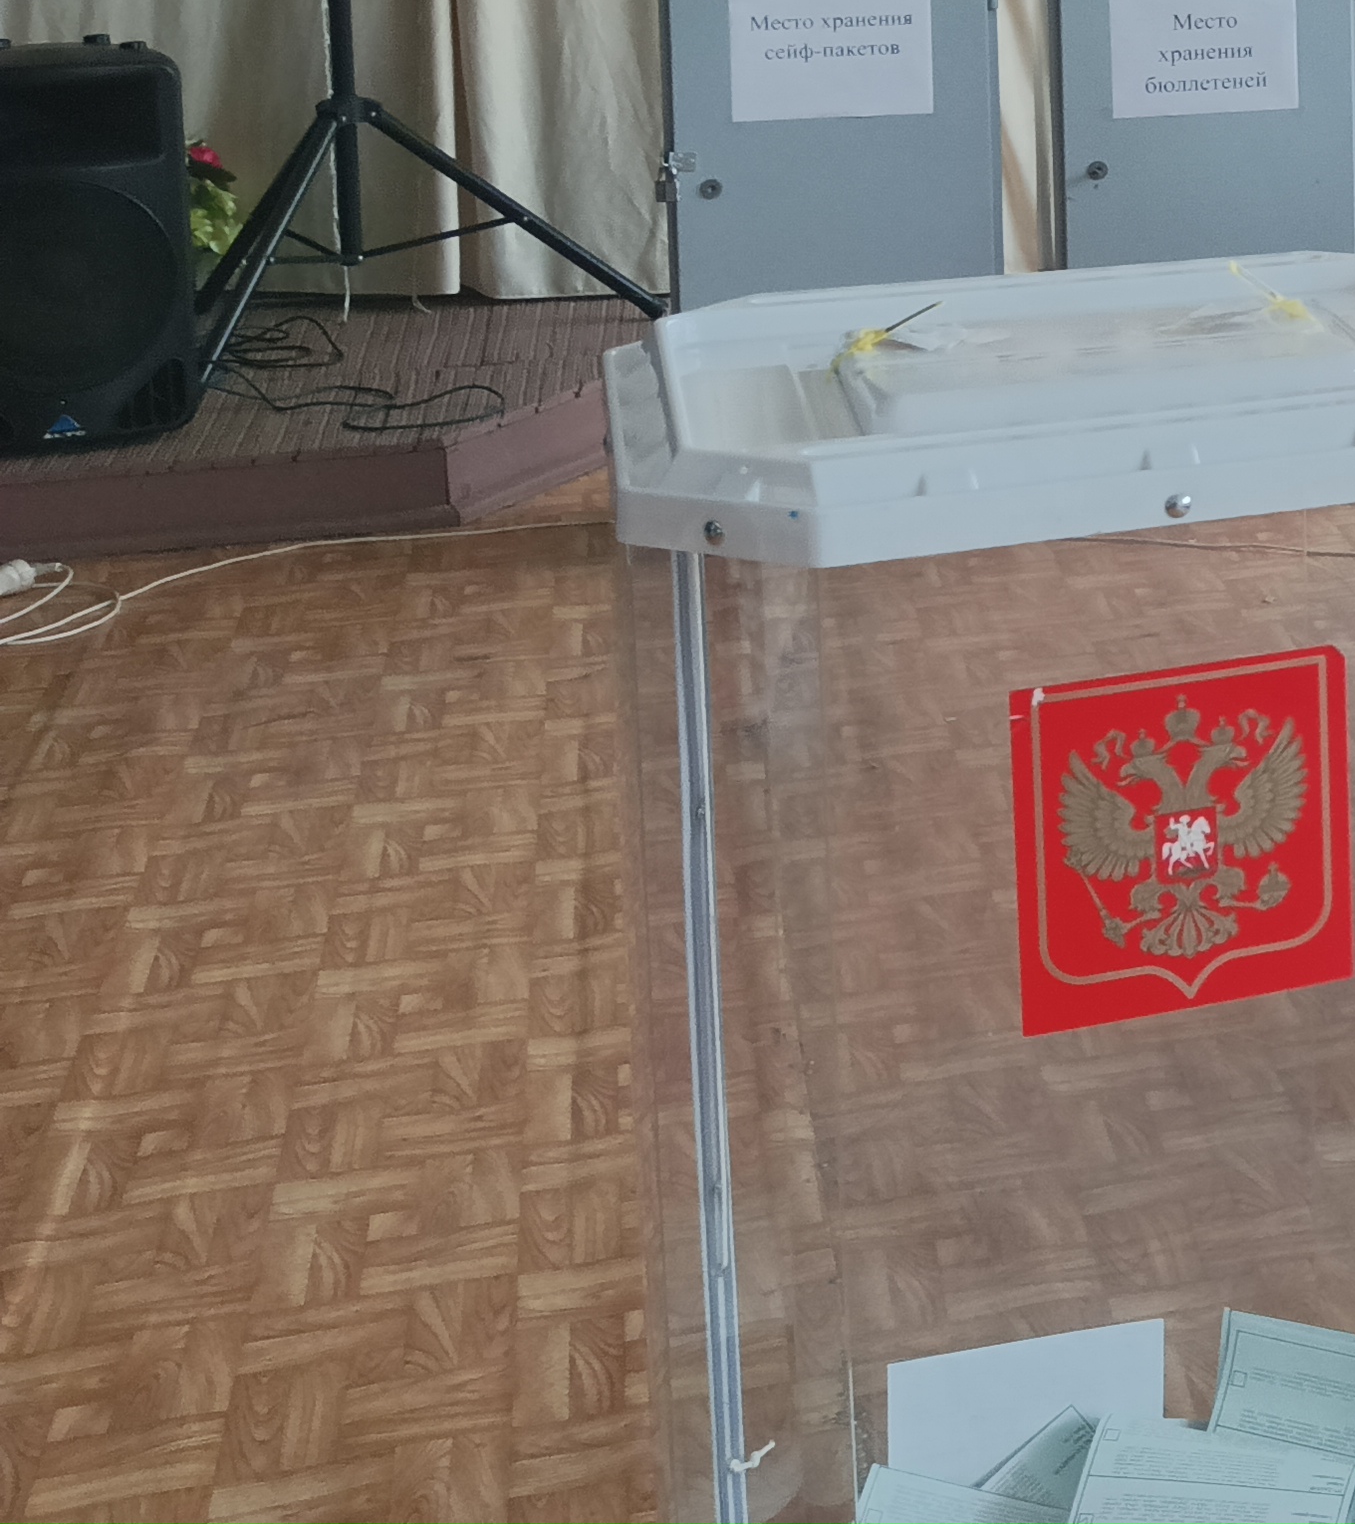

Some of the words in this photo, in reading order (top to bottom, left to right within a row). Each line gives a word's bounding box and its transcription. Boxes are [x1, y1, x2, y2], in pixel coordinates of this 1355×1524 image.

[750, 14, 814, 31] Место
[821, 14, 913, 32] хранения
[1173, 13, 1238, 30] Место
[764, 43, 901, 63] сейф-пакетов
[1158, 46, 1253, 66] хранения
[1145, 71, 1267, 94] бюллетеней
